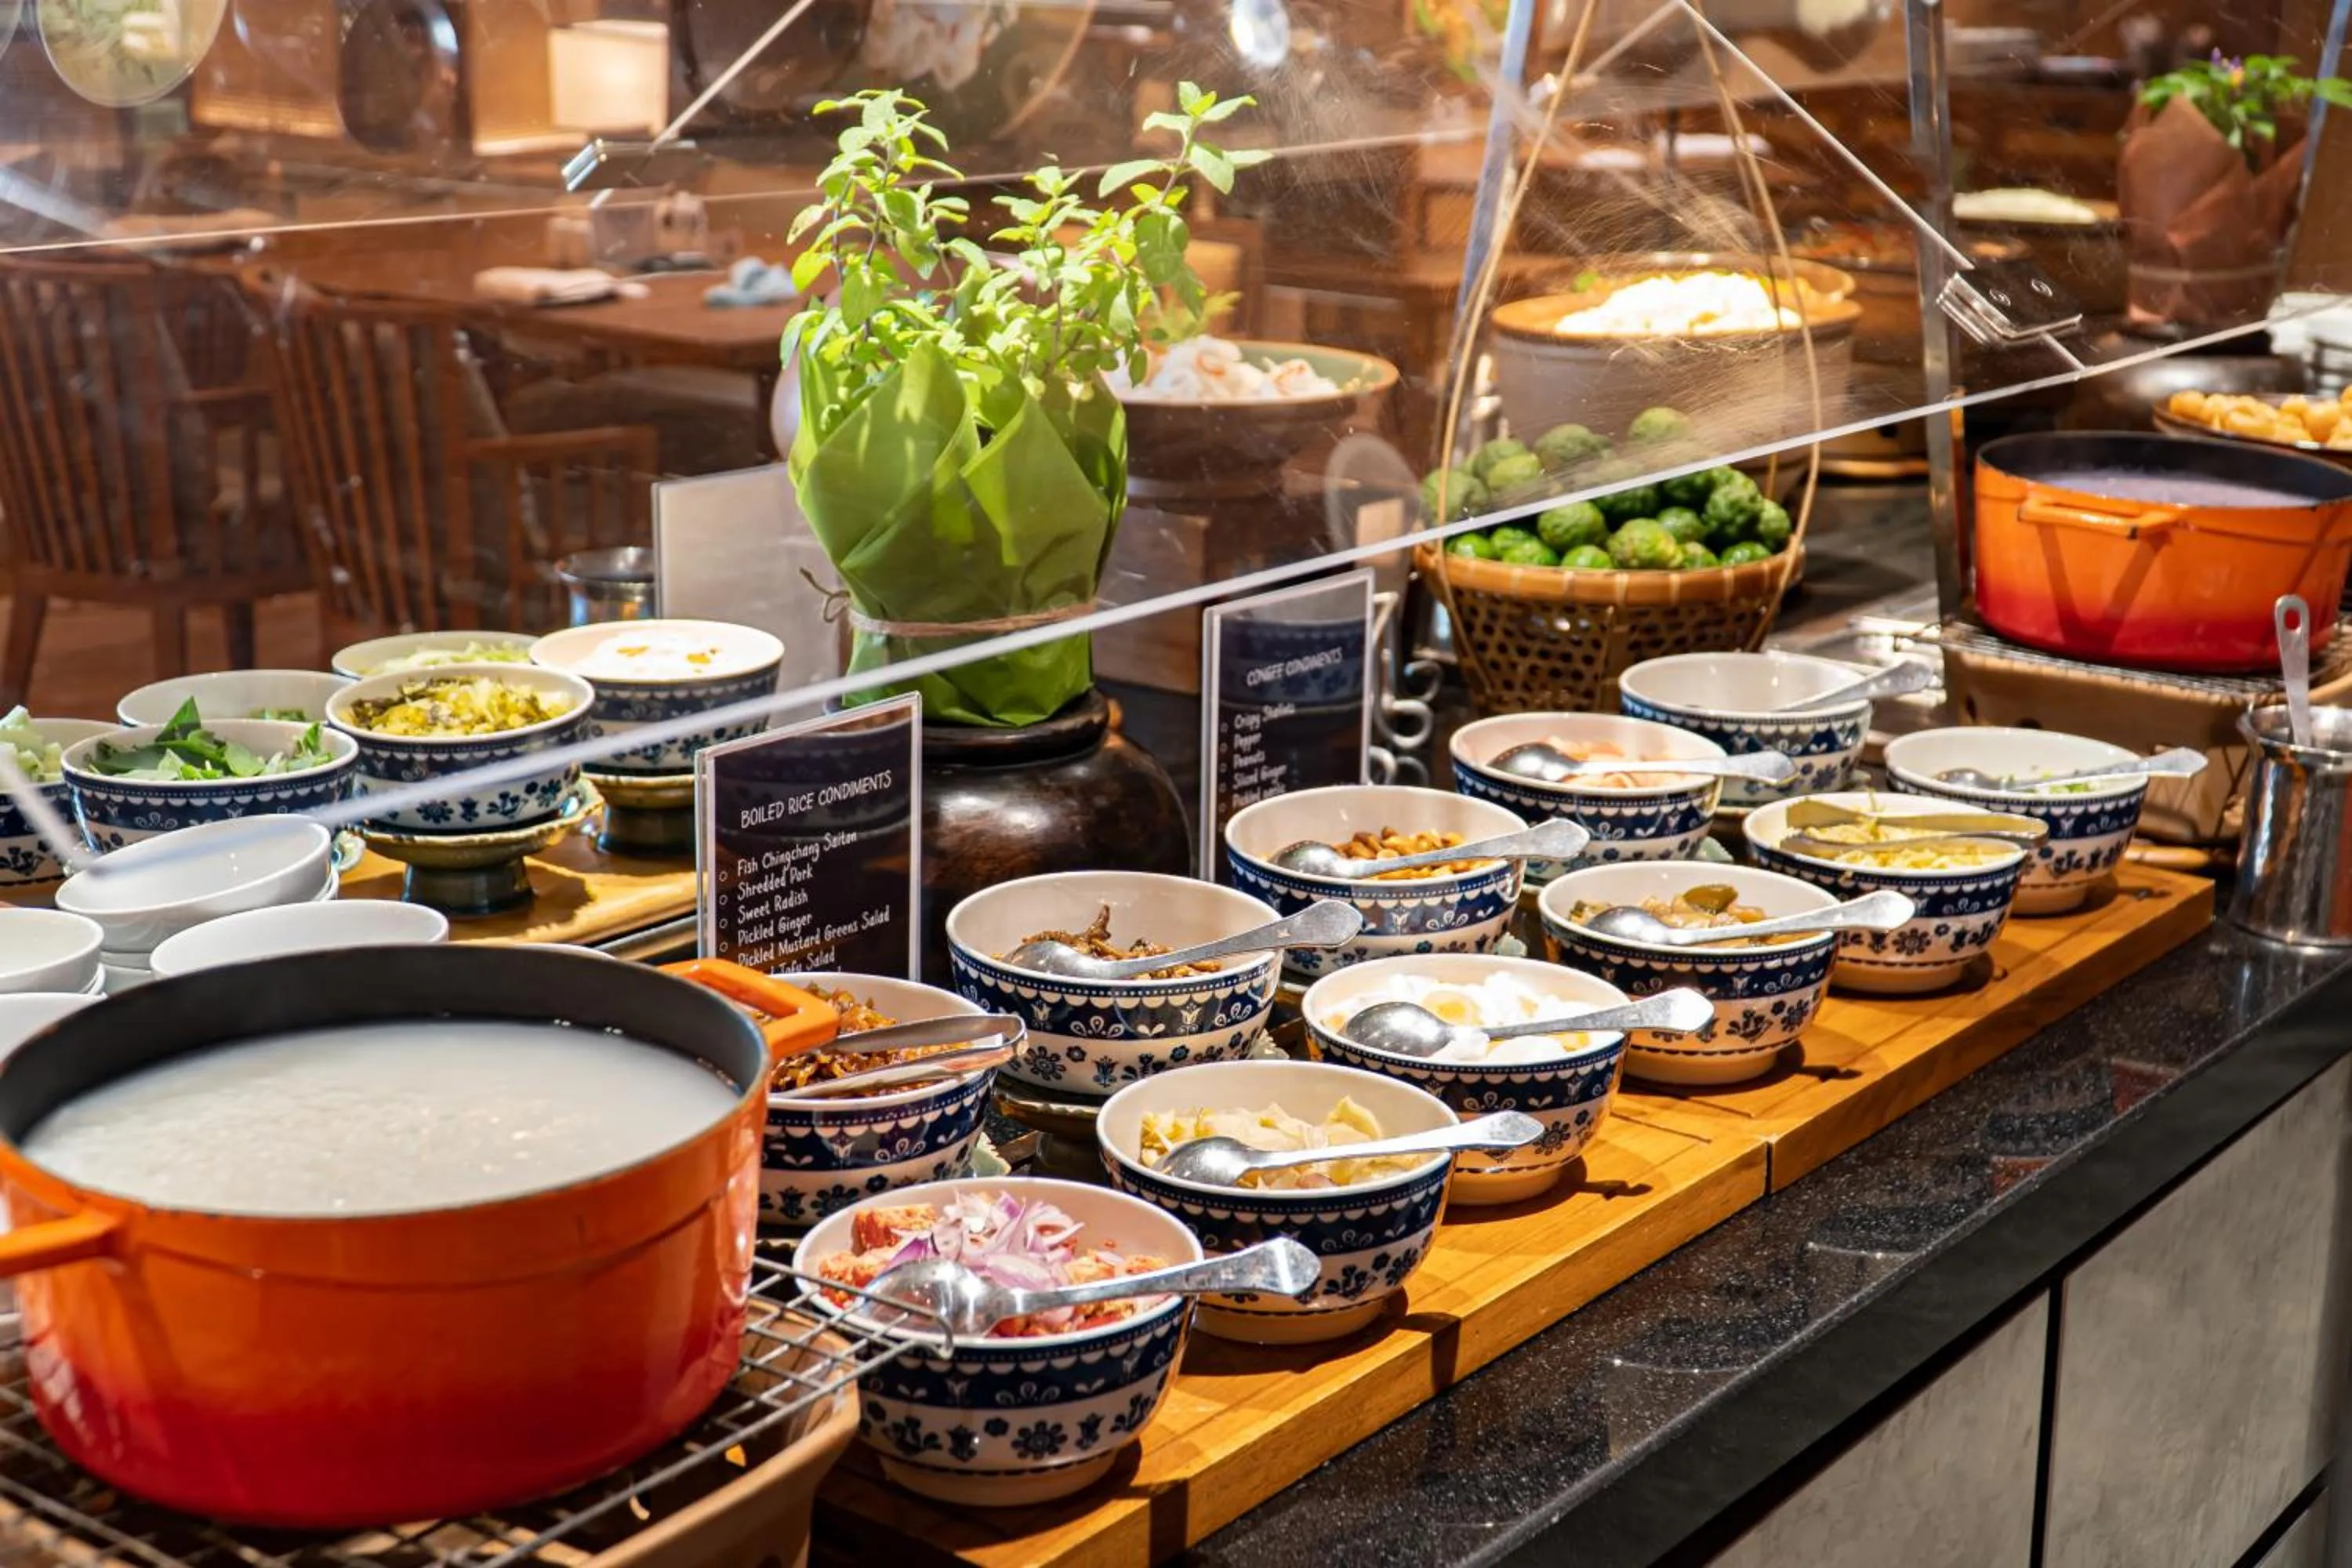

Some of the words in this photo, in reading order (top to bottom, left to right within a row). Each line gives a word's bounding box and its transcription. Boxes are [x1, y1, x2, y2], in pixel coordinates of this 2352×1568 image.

[741, 800, 784, 829] BOILED
[788, 792, 814, 815] RICE
[818, 769, 892, 806] CONDIMENTS
[738, 857, 758, 877] Fish
[762, 842, 820, 870] Chingchang
[738, 869, 786, 901] Shredded
[789, 863, 813, 884] Pork
[737, 901, 771, 925] Sweet
[775, 889, 808, 911] Radish
[738, 920, 774, 947] Pickled
[778, 913, 813, 937] Ginger
[738, 944, 774, 967] Pickled
[779, 927, 820, 956] Mustard
[824, 920, 858, 942] Greens
[862, 905, 891, 930] Salad
[806, 946, 836, 970] Salad
